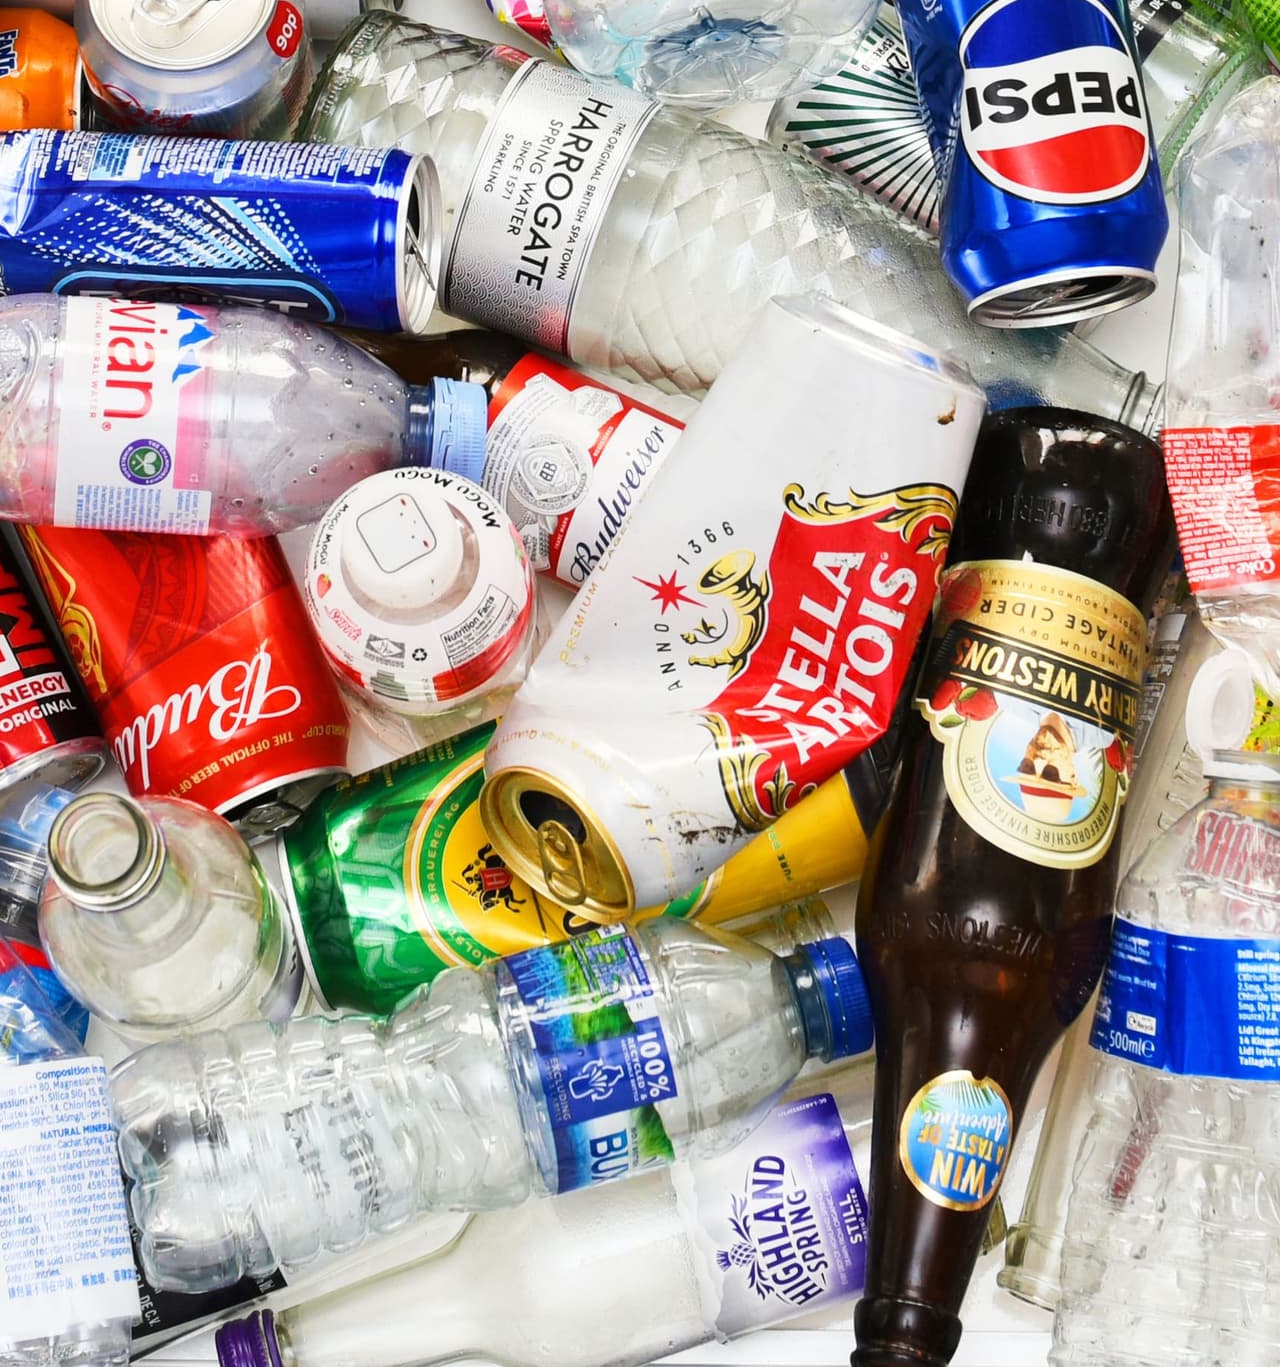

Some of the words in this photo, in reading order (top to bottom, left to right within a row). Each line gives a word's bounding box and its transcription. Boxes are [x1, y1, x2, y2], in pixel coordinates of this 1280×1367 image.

[965, 69, 1142, 132] PEPSI
[484, 132, 514, 193] SPARKLING
[513, 140, 532, 173] SINCE
[529, 119, 564, 175] SPRING
[595, 137, 618, 181] ORIGINAL
[507, 182, 537, 235] WATER
[515, 97, 613, 291] HARROGATE
[577, 185, 596, 223] BRITISH
[556, 250, 574, 280] TOWN
[735, 549, 866, 723] STELLA
[980, 598, 1054, 622] CIDER
[779, 566, 919, 765] ARTOIS
[929, 1148, 986, 1200] WIN
[751, 1154, 822, 1307] HIGHLAND
[782, 1187, 830, 1277] SPRING
